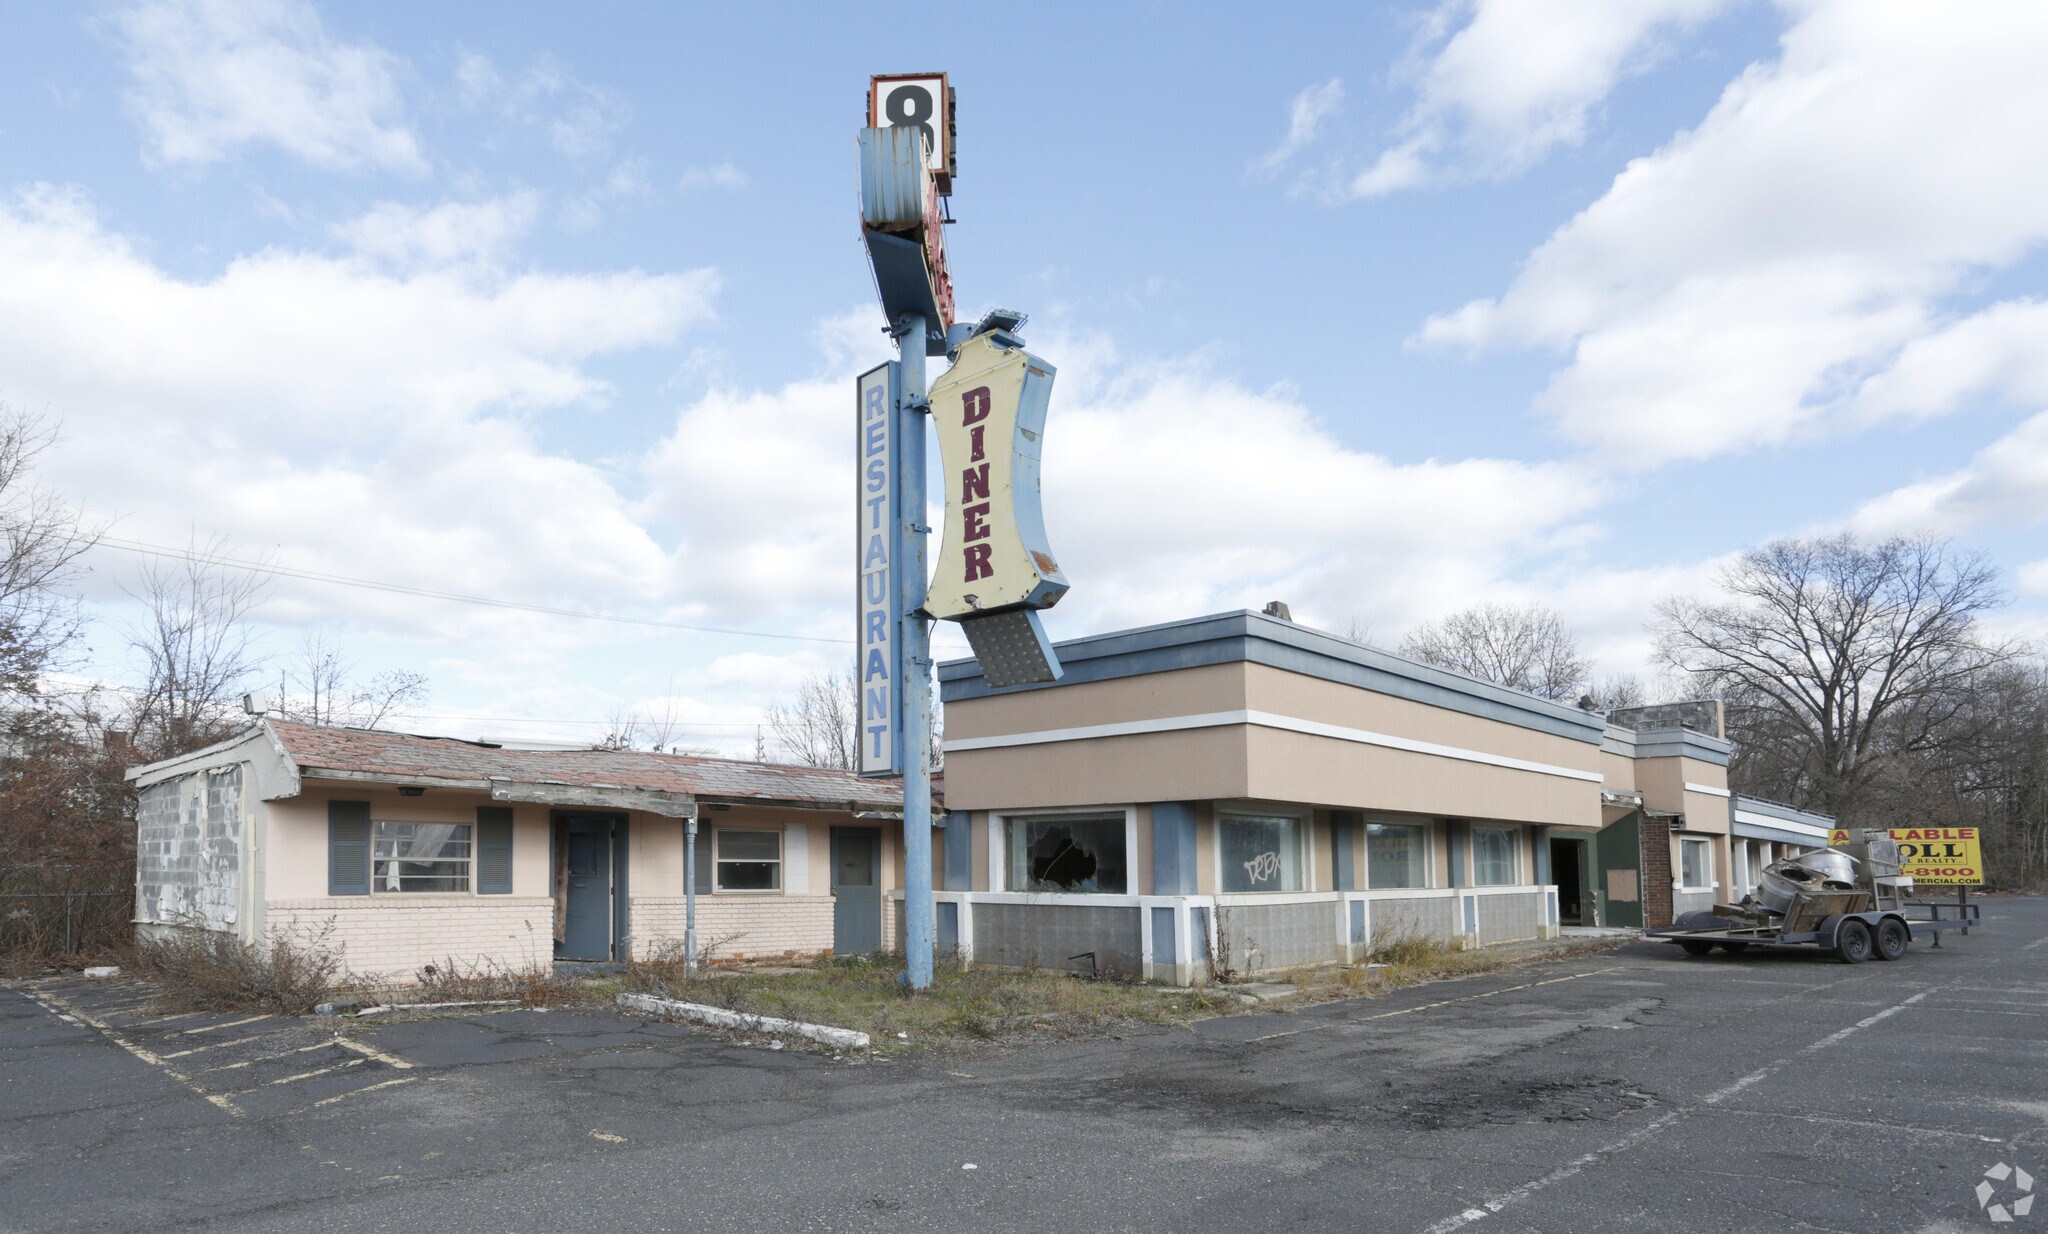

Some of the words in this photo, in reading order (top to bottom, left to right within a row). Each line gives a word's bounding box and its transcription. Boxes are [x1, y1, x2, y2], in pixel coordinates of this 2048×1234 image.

[886, 85, 934, 156] 8
[961, 385, 994, 583] DINER
[865, 383, 888, 759] RESTAURANT
[1833, 829, 1975, 841] ALABLE
[1898, 843, 1963, 858] OLL
